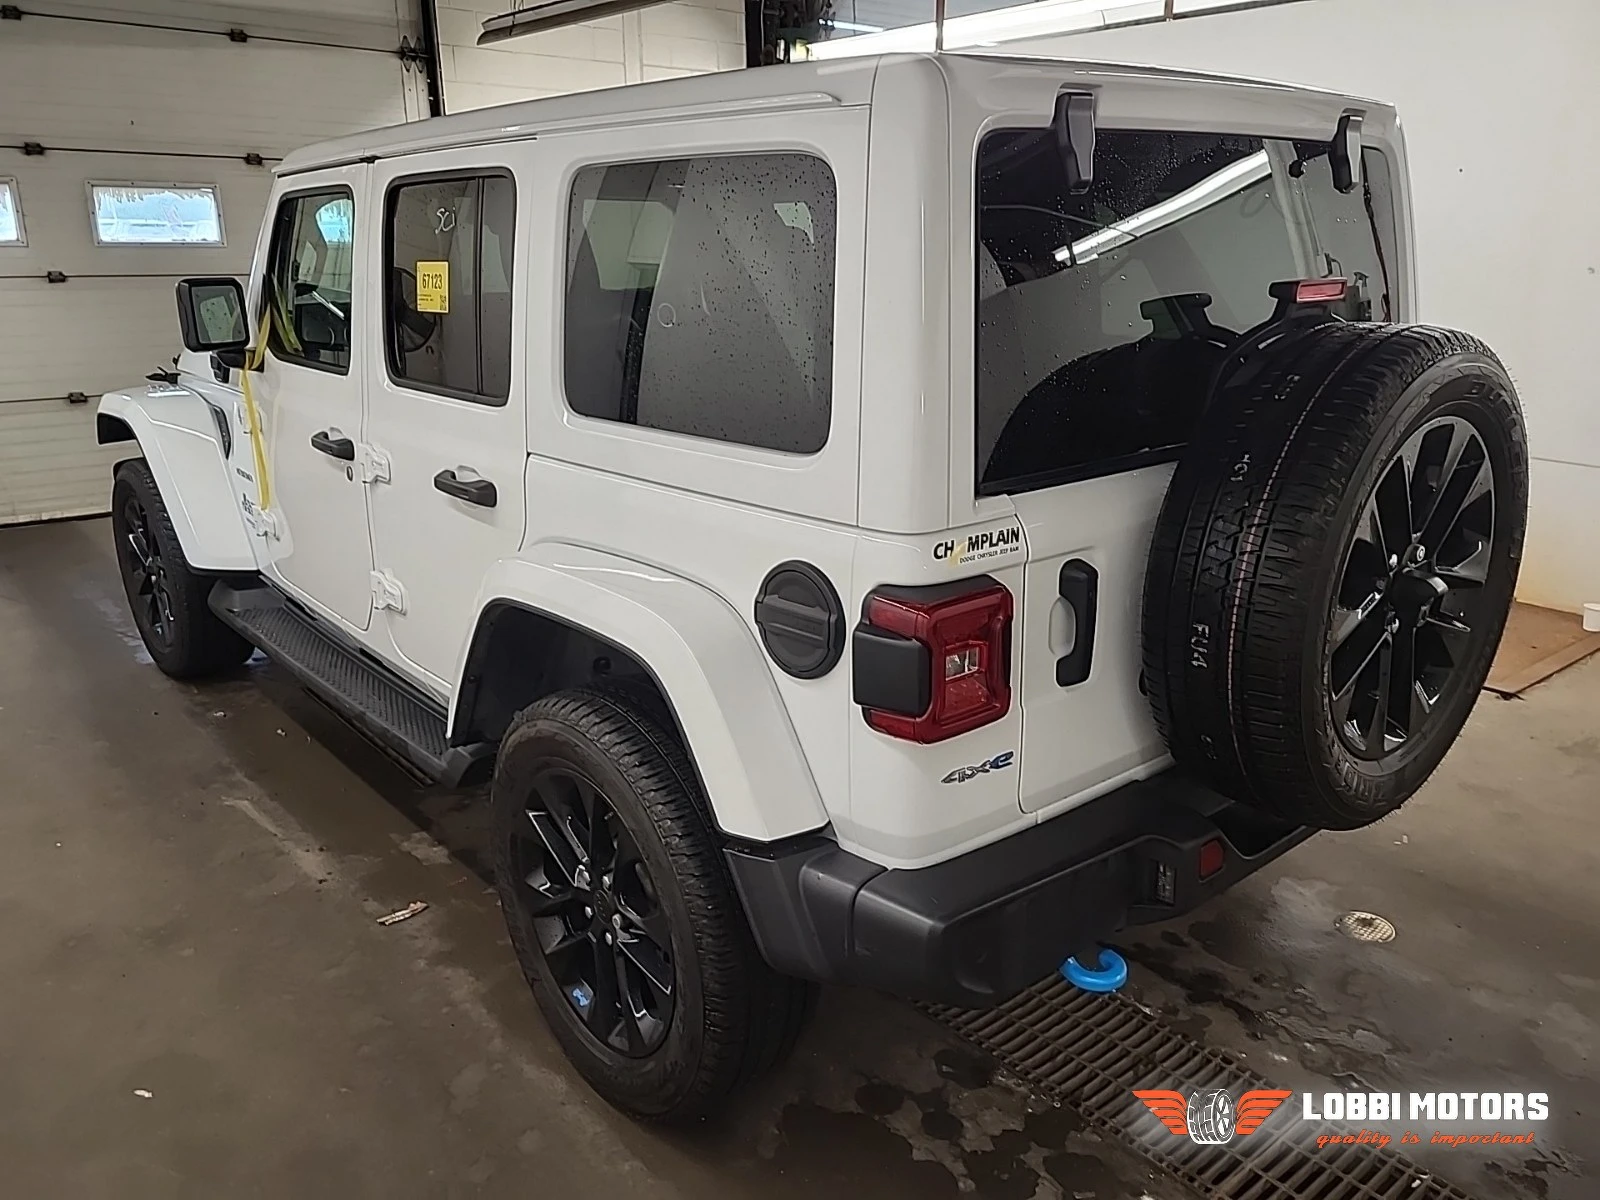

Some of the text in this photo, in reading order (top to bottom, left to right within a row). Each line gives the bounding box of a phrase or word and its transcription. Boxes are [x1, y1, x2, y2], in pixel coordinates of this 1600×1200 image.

[422, 273, 443, 290] 67123
[959, 554, 976, 564] DODGE
[977, 550, 998, 560] CHRYSLER
